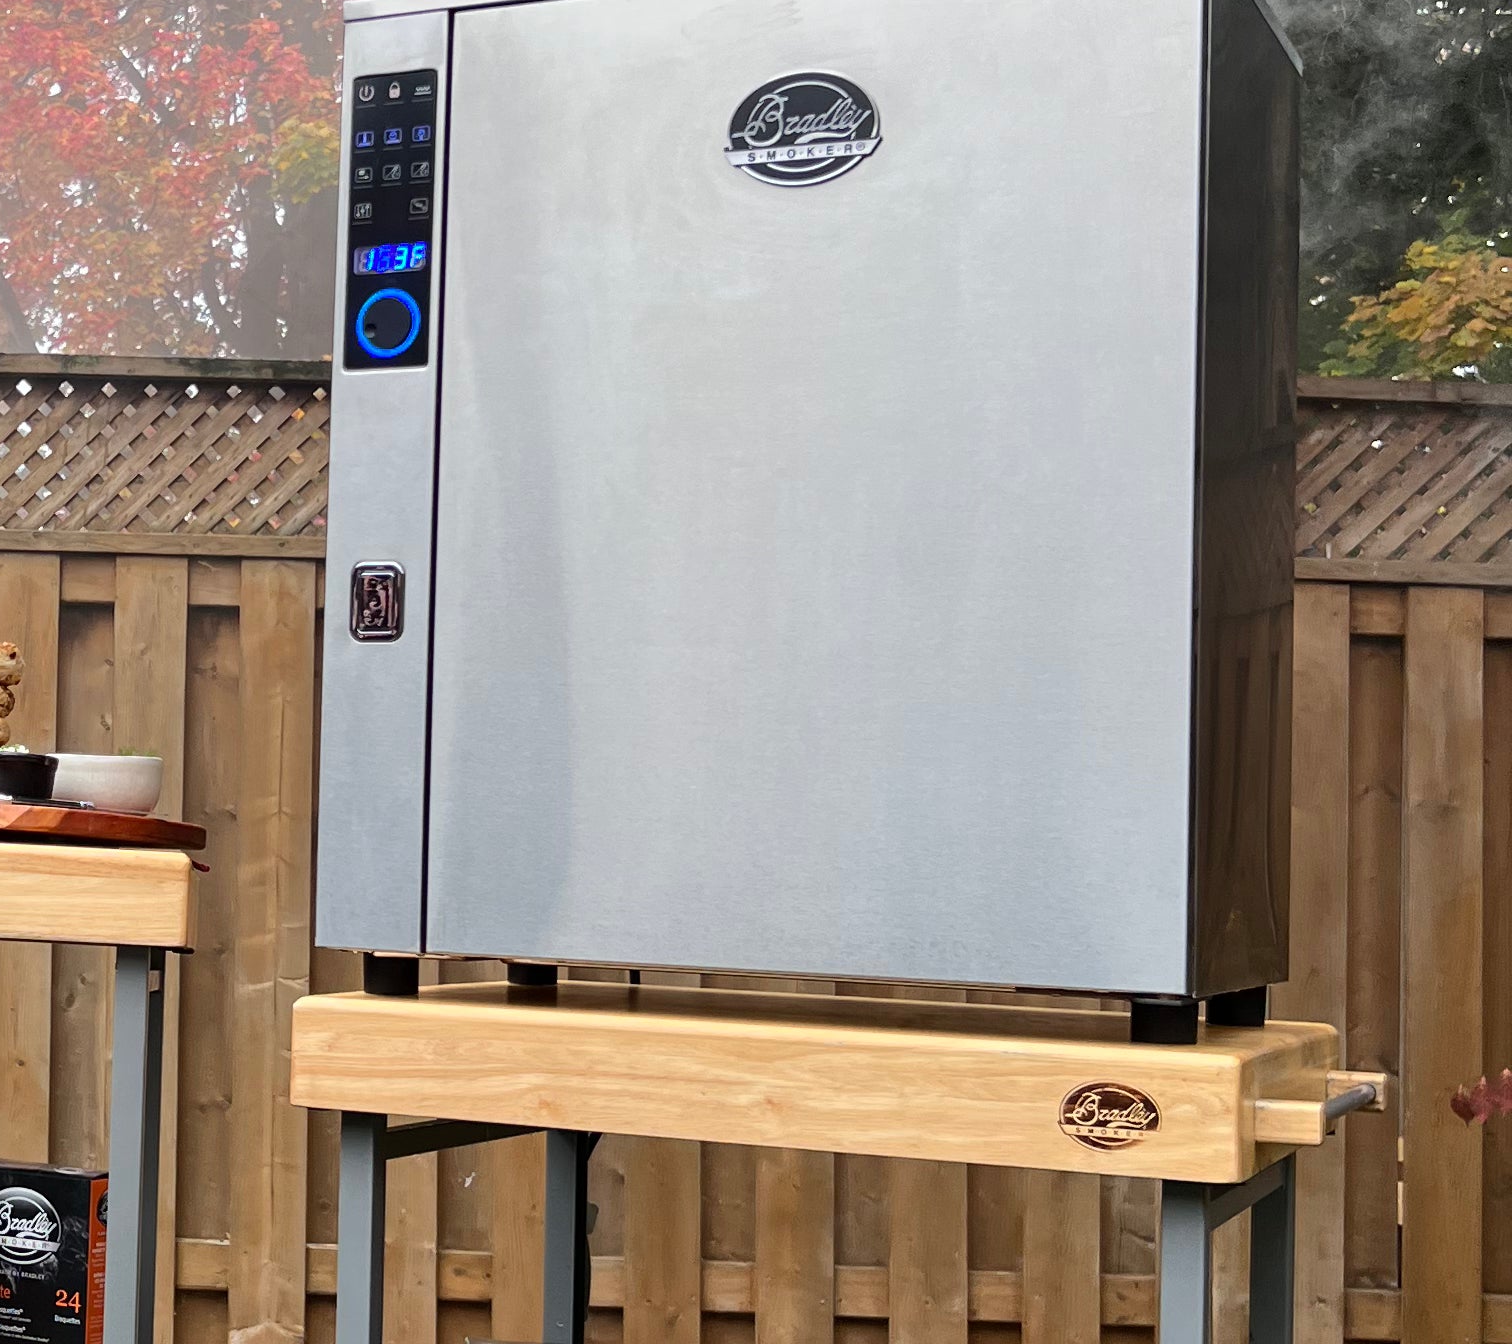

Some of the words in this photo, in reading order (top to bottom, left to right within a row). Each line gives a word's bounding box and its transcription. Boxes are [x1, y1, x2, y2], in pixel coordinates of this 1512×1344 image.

[731, 93, 872, 147] Bradley
[1065, 1092, 1156, 1128] Bradley
[55, 1289, 82, 1314] 24
